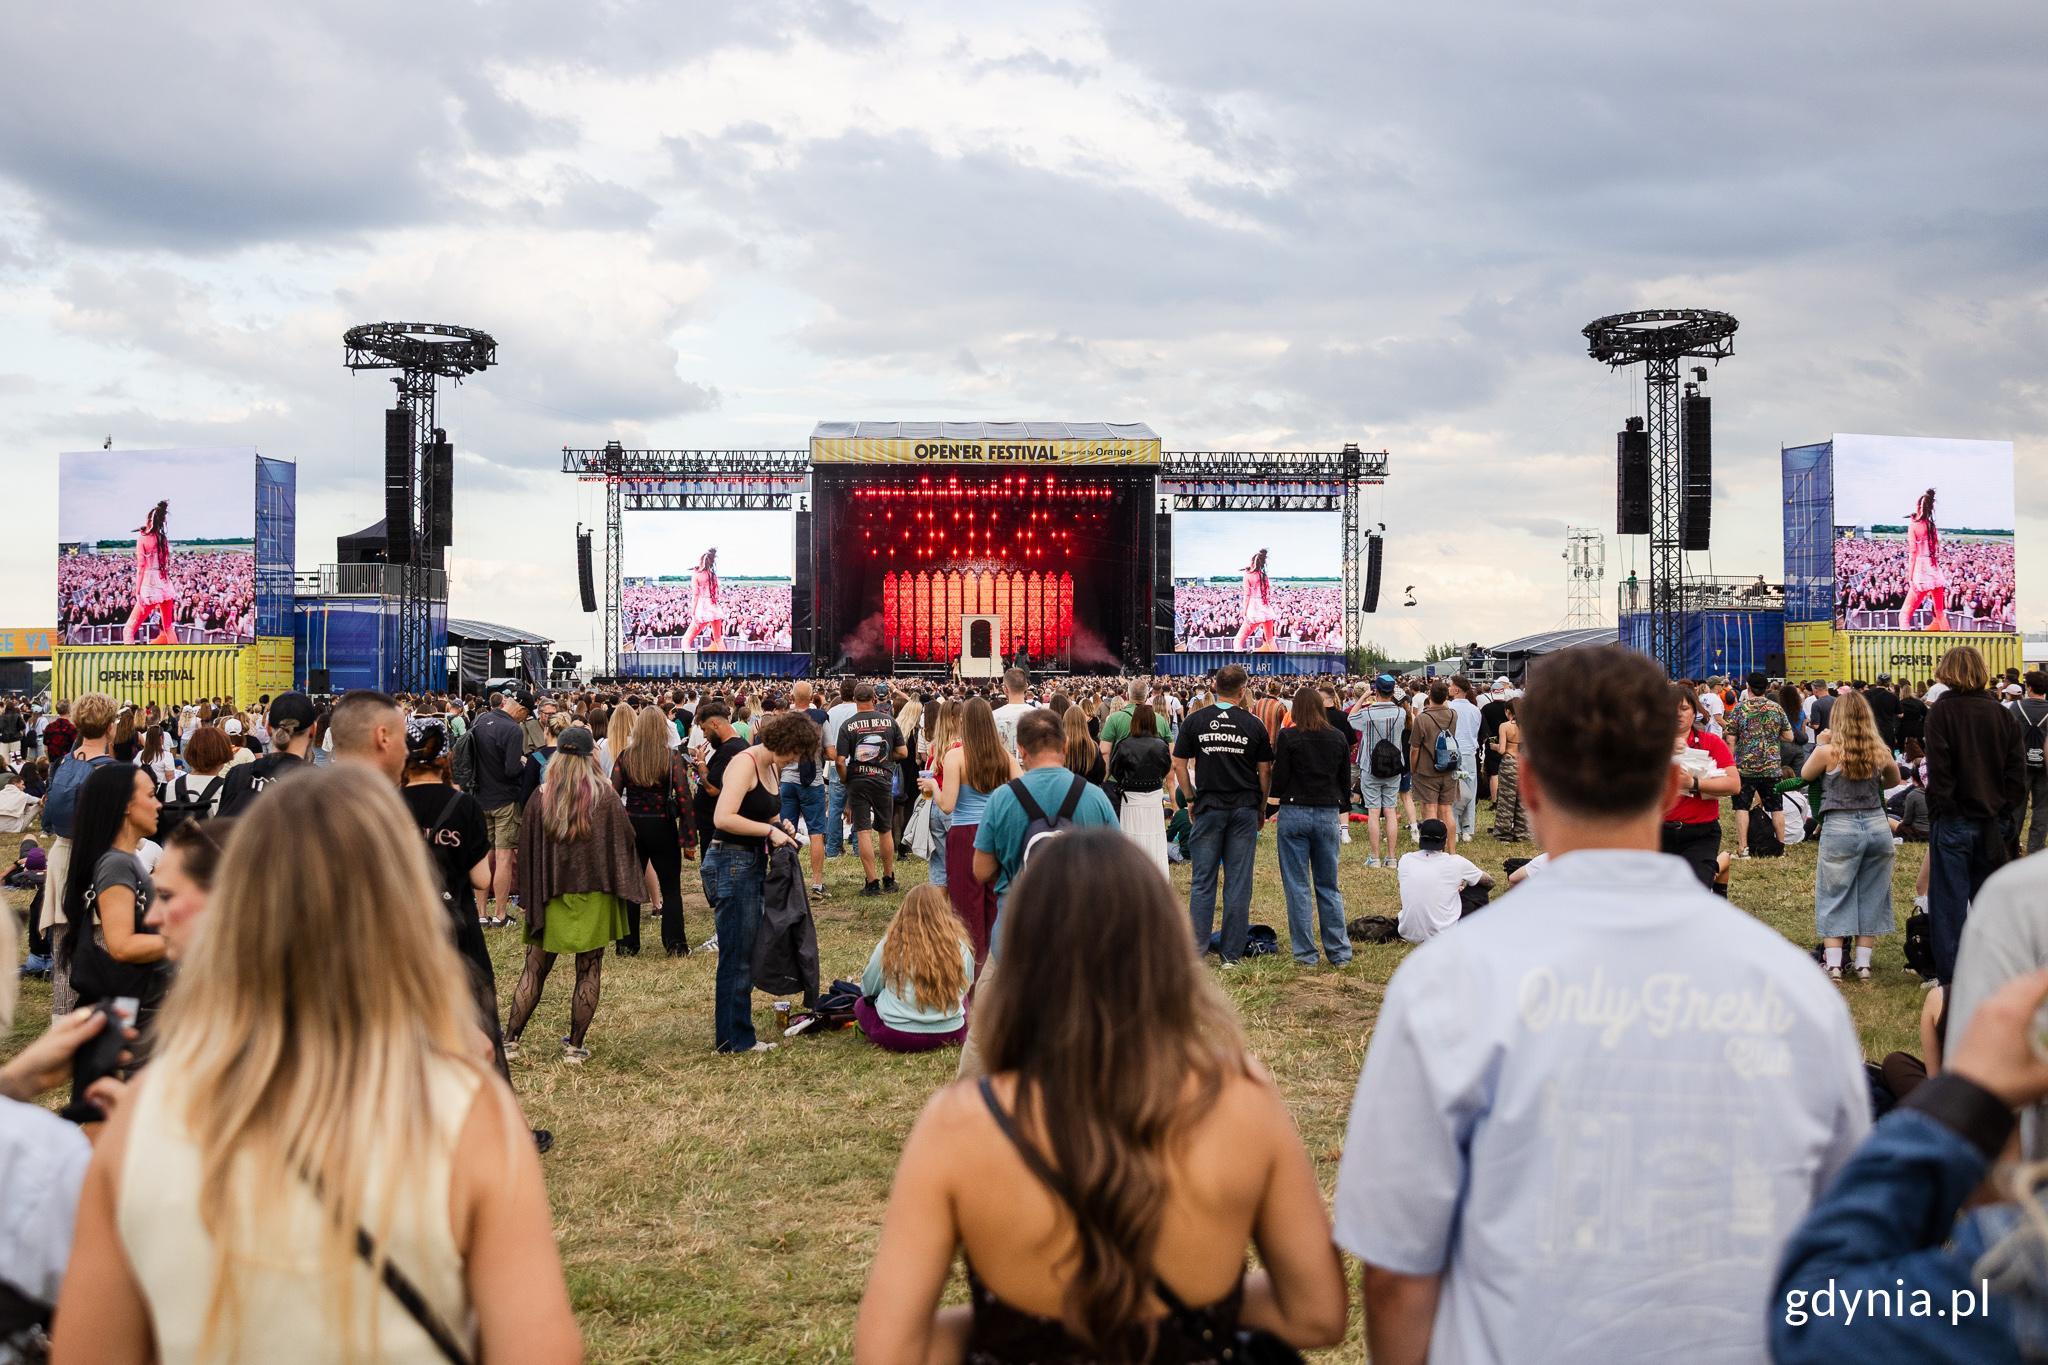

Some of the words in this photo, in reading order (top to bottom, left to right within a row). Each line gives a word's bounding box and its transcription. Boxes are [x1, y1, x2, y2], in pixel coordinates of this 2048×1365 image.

[914, 444, 983, 459] OPEN'ER
[988, 444, 1058, 460] FESTIVAL
[1095, 447, 1132, 457] Orange
[25, 632, 49, 652] YA
[721, 661, 737, 671] ART
[1256, 662, 1272, 672] ART
[99, 670, 145, 682] OPEN'ER
[148, 669, 195, 681] FESTIVAL
[847, 719, 870, 732] SOUTH
[870, 718, 892, 728] BEACH
[1198, 732, 1249, 745] PETRONAS
